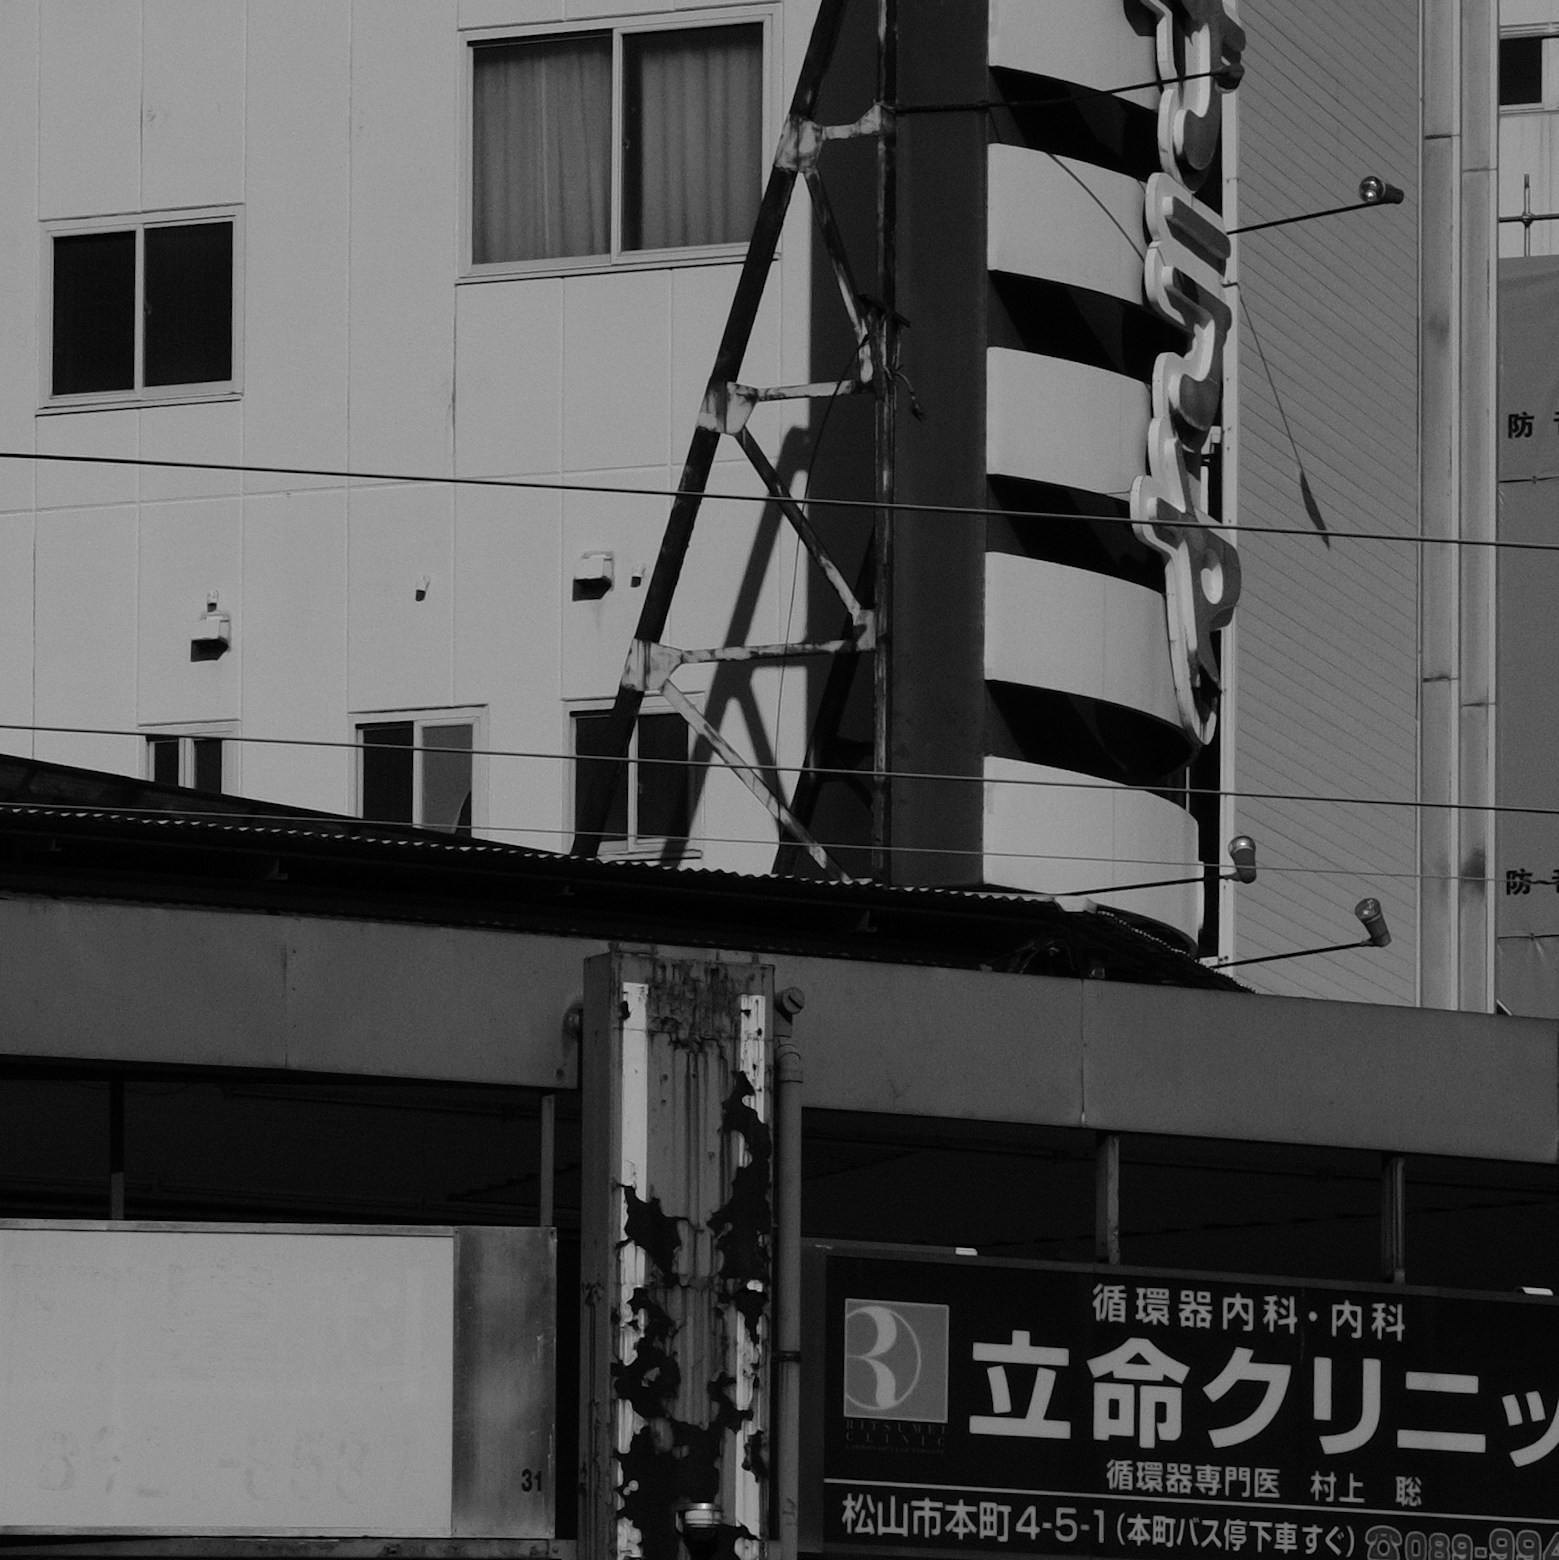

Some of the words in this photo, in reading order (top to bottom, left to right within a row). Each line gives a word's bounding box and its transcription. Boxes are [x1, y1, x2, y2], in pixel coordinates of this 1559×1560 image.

[1092, 1283, 1406, 1342] 循環器内科・内科
[521, 1468, 542, 1492] 31
[1106, 1458, 1281, 1498] 循環器専門医
[1310, 1470, 1366, 1503] 村上
